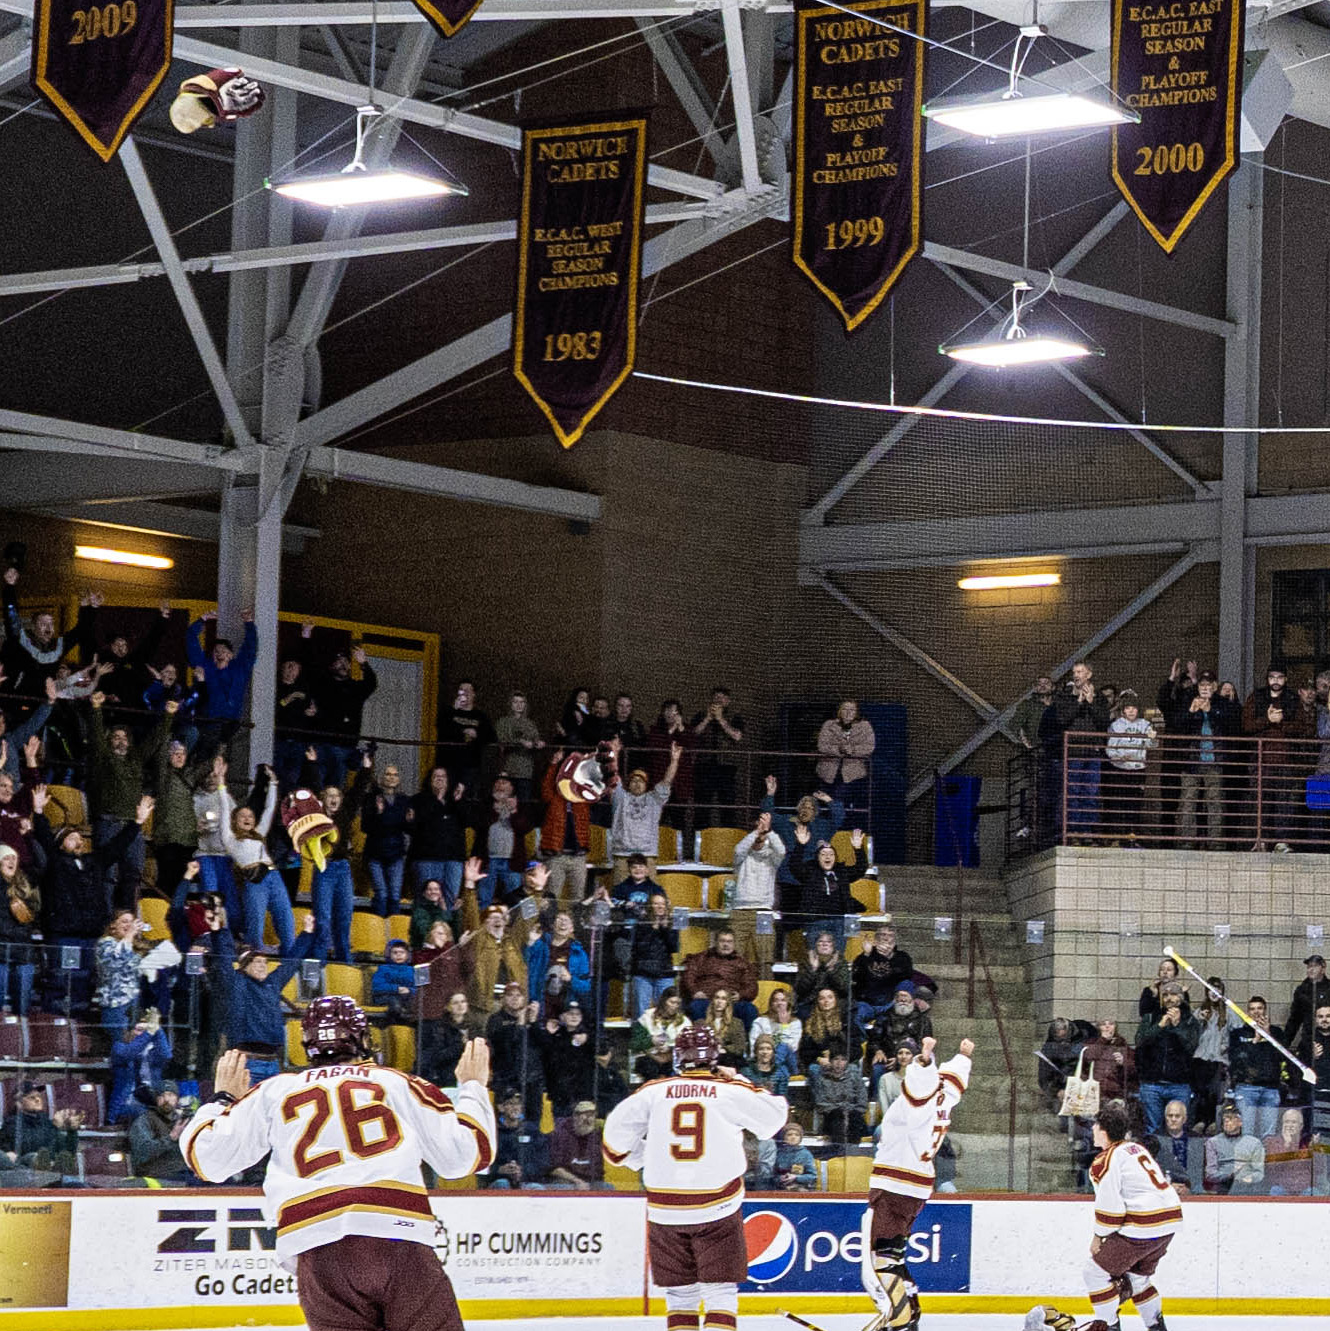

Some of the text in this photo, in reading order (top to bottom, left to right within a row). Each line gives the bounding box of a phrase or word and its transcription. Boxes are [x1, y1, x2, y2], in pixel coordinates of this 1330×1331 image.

[69, 0, 138, 45] 2009
[1134, 143, 1204, 176] 2000
[824, 216, 885, 250] 1999
[544, 331, 601, 362] 1983
[318, 1028, 335, 1040] 26
[305, 1066, 370, 1083] FAGAN
[666, 1084, 717, 1099] KUDRNA
[281, 1079, 403, 1179] 26
[671, 1102, 706, 1161] 9
[456, 1232, 602, 1254] HP CUMMINGS
[805, 1224, 941, 1271] pesi
[154, 1258, 206, 1271] ZITER
[457, 1258, 602, 1267] CONSTRUCTION COMPANY
[196, 1275, 224, 1295] Go
